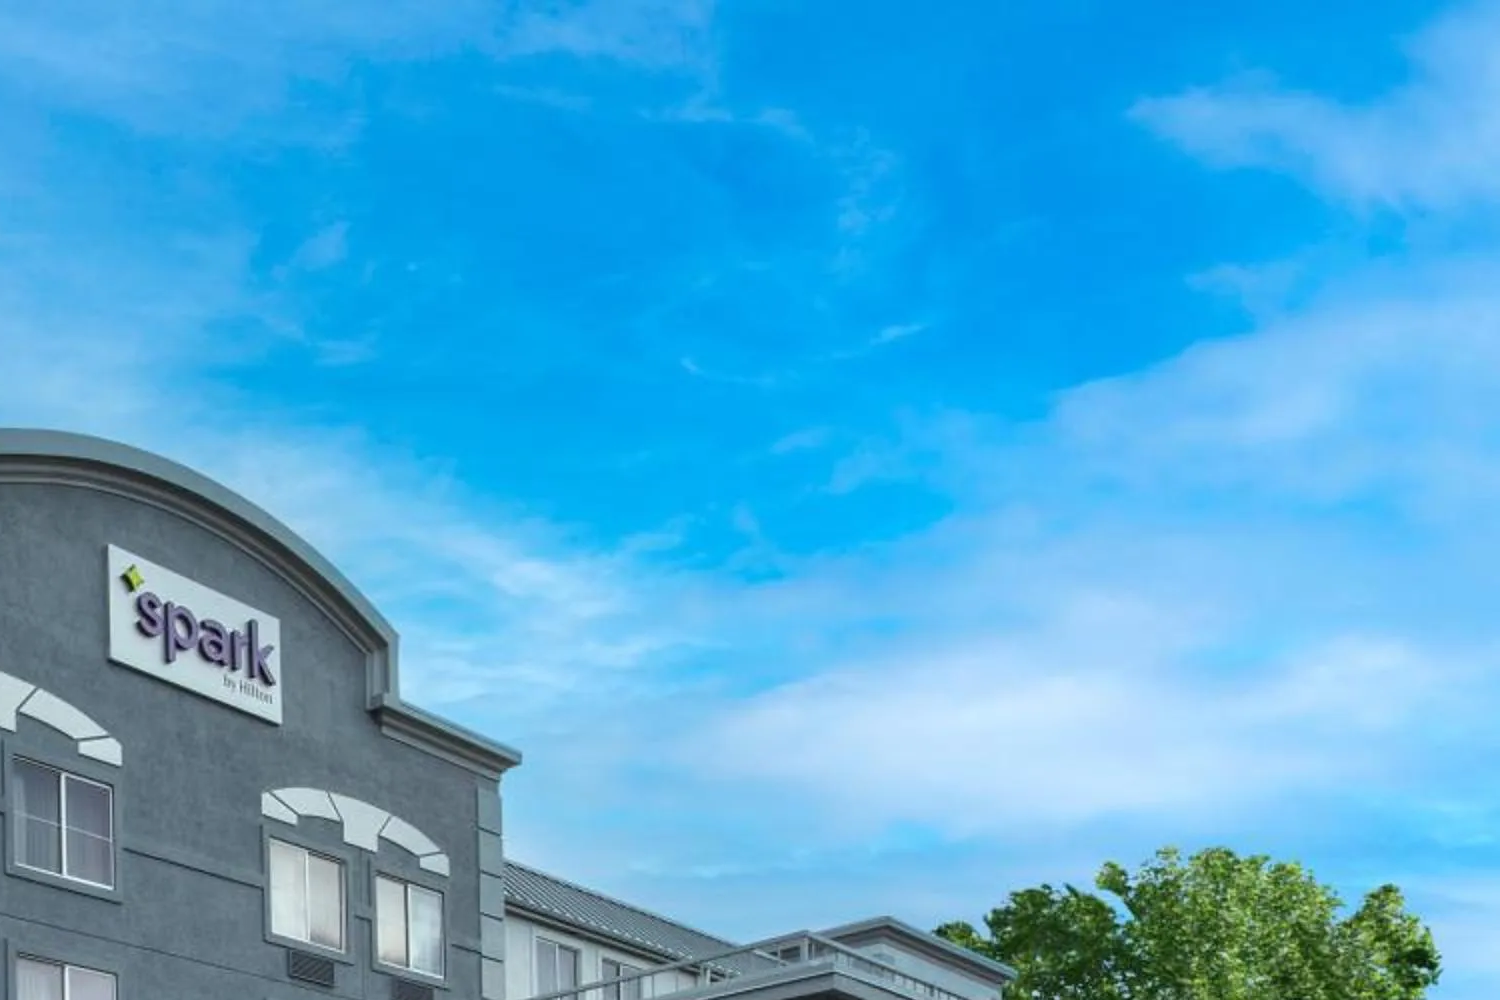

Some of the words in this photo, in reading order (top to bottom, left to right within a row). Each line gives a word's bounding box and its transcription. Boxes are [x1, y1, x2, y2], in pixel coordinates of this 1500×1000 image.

[135, 591, 276, 686] spark
[223, 674, 236, 692] by
[240, 680, 273, 705] Hilton
